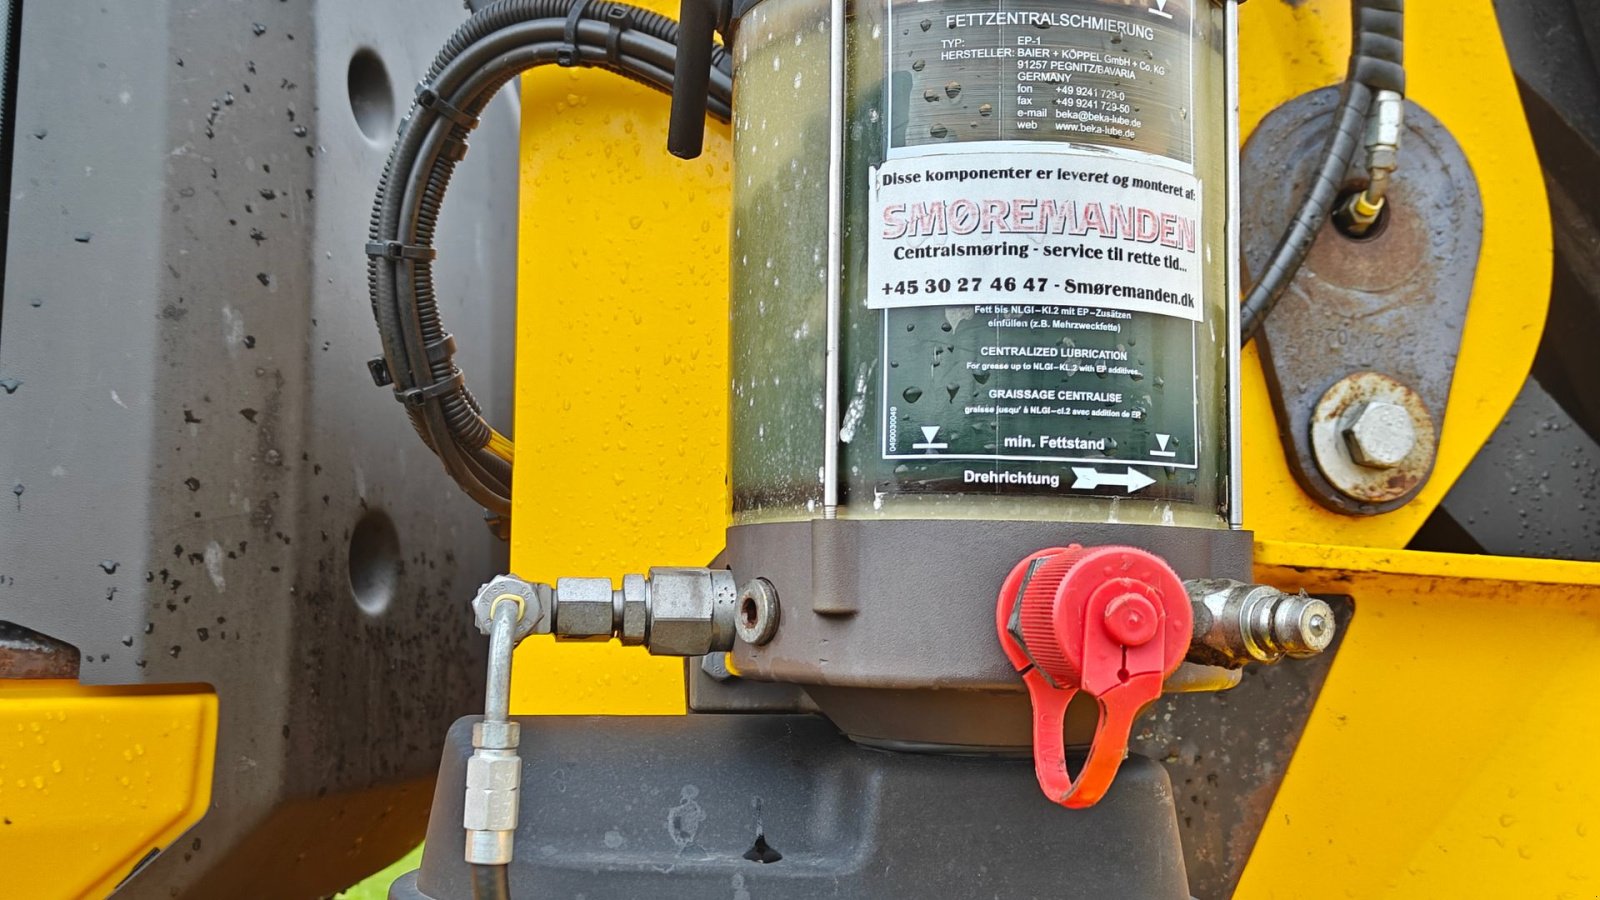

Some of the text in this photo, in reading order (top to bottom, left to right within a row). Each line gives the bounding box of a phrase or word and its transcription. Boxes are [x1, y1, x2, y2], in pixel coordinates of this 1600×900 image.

[946, 12, 1154, 40] FETTZENTRALSCHMIERUNG
[941, 36, 1041, 49] TYP: EP-1
[941, 48, 1015, 61] HERSTELLER:
[1018, 48, 1050, 58] BAIER
[1062, 49, 1102, 62] KÖPPEL
[1104, 54, 1130, 66] GmbH
[1154, 65, 1165, 76] KG
[1017, 61, 1136, 80] 91257 PEGNITZ/BAVARIA
[1017, 72, 1071, 82] GERMANY
[1017, 84, 1125, 100] fon +49 9241 729-0
[1017, 96, 1130, 113] fax +49 9241 729-50
[1017, 108, 1141, 128] e-mail beka@beka-lube.de
[1017, 120, 1135, 138] web www.beka-lube.de
[882, 167, 1196, 201] Disse komponenter er leveret og monteret af:
[882, 199, 1196, 253] SMØREMANDEN
[894, 242, 1029, 260] Centralsmøring
[1043, 245, 1103, 260] service
[1107, 247, 1123, 262] til
[1127, 250, 1160, 266] rette
[882, 280, 919, 295] +45
[925, 279, 950, 294] 30
[958, 279, 982, 292] 27
[990, 278, 1016, 292] 46
[1023, 278, 1048, 292] 47
[1064, 279, 1195, 309] Smøremanden.dk
[974, 305, 992, 314] Fett
[994, 305, 1008, 314] bis
[1062, 306, 1076, 315] mit
[988, 319, 1121, 333] einfüllen (z.B. Mehrzweckfette)
[980, 346, 1127, 361] CENTRALIZED LUBRICATION
[966, 362, 980, 370] For
[982, 363, 1008, 372] grease
[1011, 364, 1020, 372] up
[1079, 364, 1095, 373] with
[1096, 365, 1106, 373] EP
[988, 389, 1122, 403] GRAISSAGE CENTRALISE
[965, 406, 994, 415] graisse
[1004, 436, 1105, 450] min. Fettstand
[964, 470, 1059, 487] Drehrichtung
